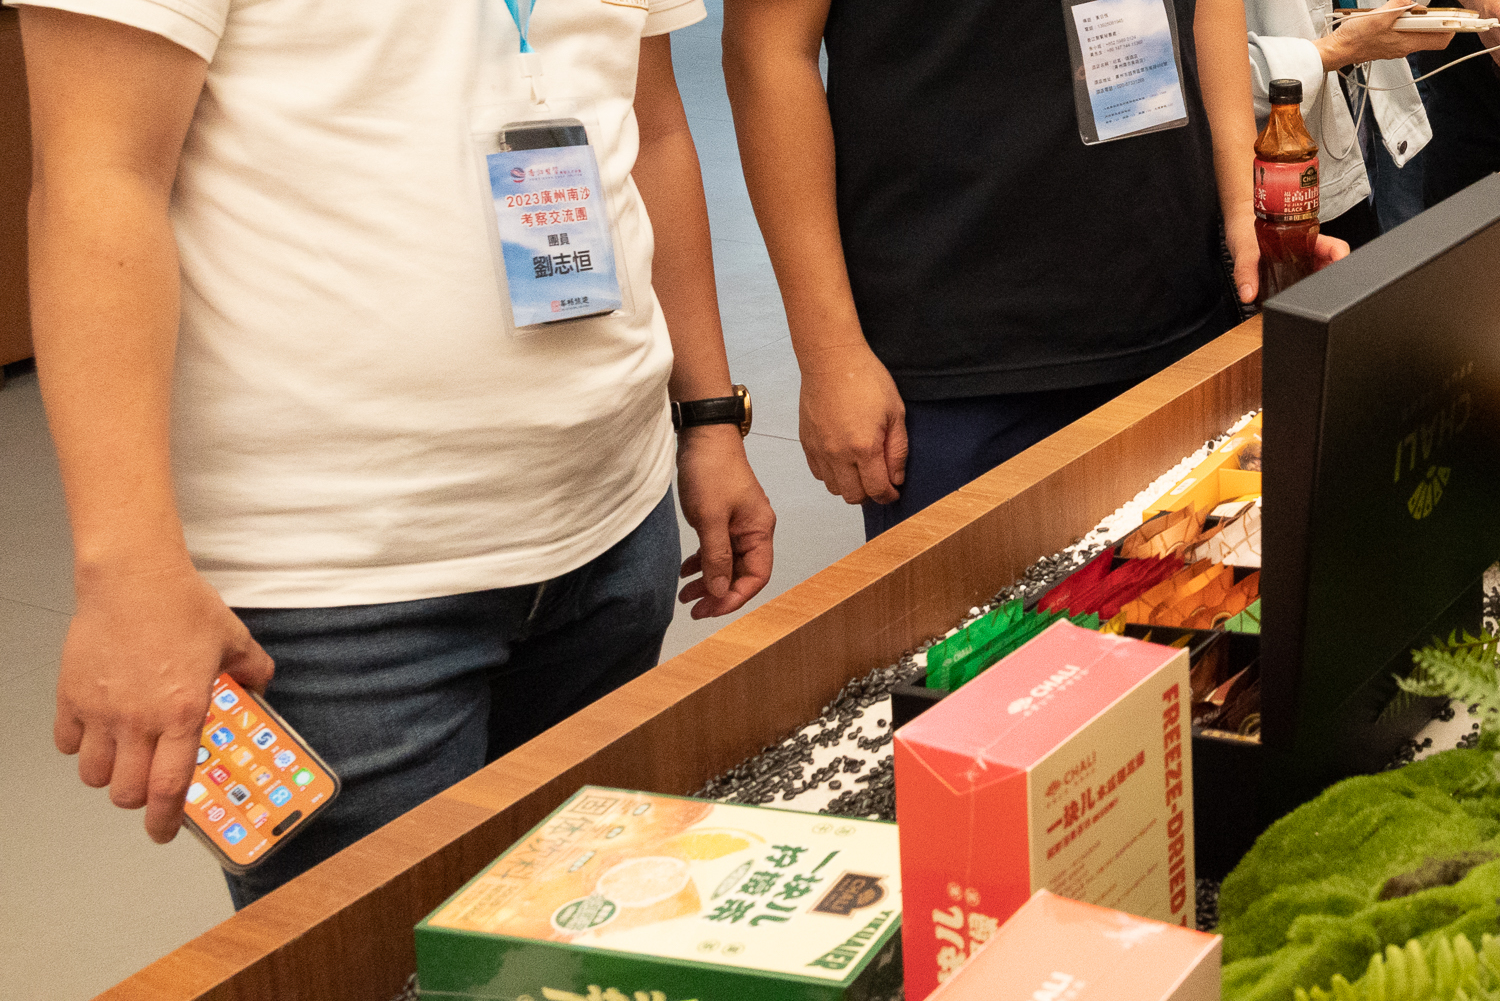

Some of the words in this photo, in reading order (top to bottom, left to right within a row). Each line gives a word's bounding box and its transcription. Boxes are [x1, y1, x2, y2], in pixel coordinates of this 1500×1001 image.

[506, 186, 591, 208] 2023廣州南沙
[520, 206, 588, 228] 考察交流團
[547, 232, 570, 247] 團員
[532, 250, 593, 279] 劉志恒
[1031, 664, 1081, 698] CHALI
[1063, 750, 1097, 785] CHALI
[1162, 682, 1187, 915] FREEZE-DRIED
[703, 844, 809, 924] 柠檬茶
[748, 850, 841, 927] 一块儿
[805, 910, 895, 970] YIKUAIER
